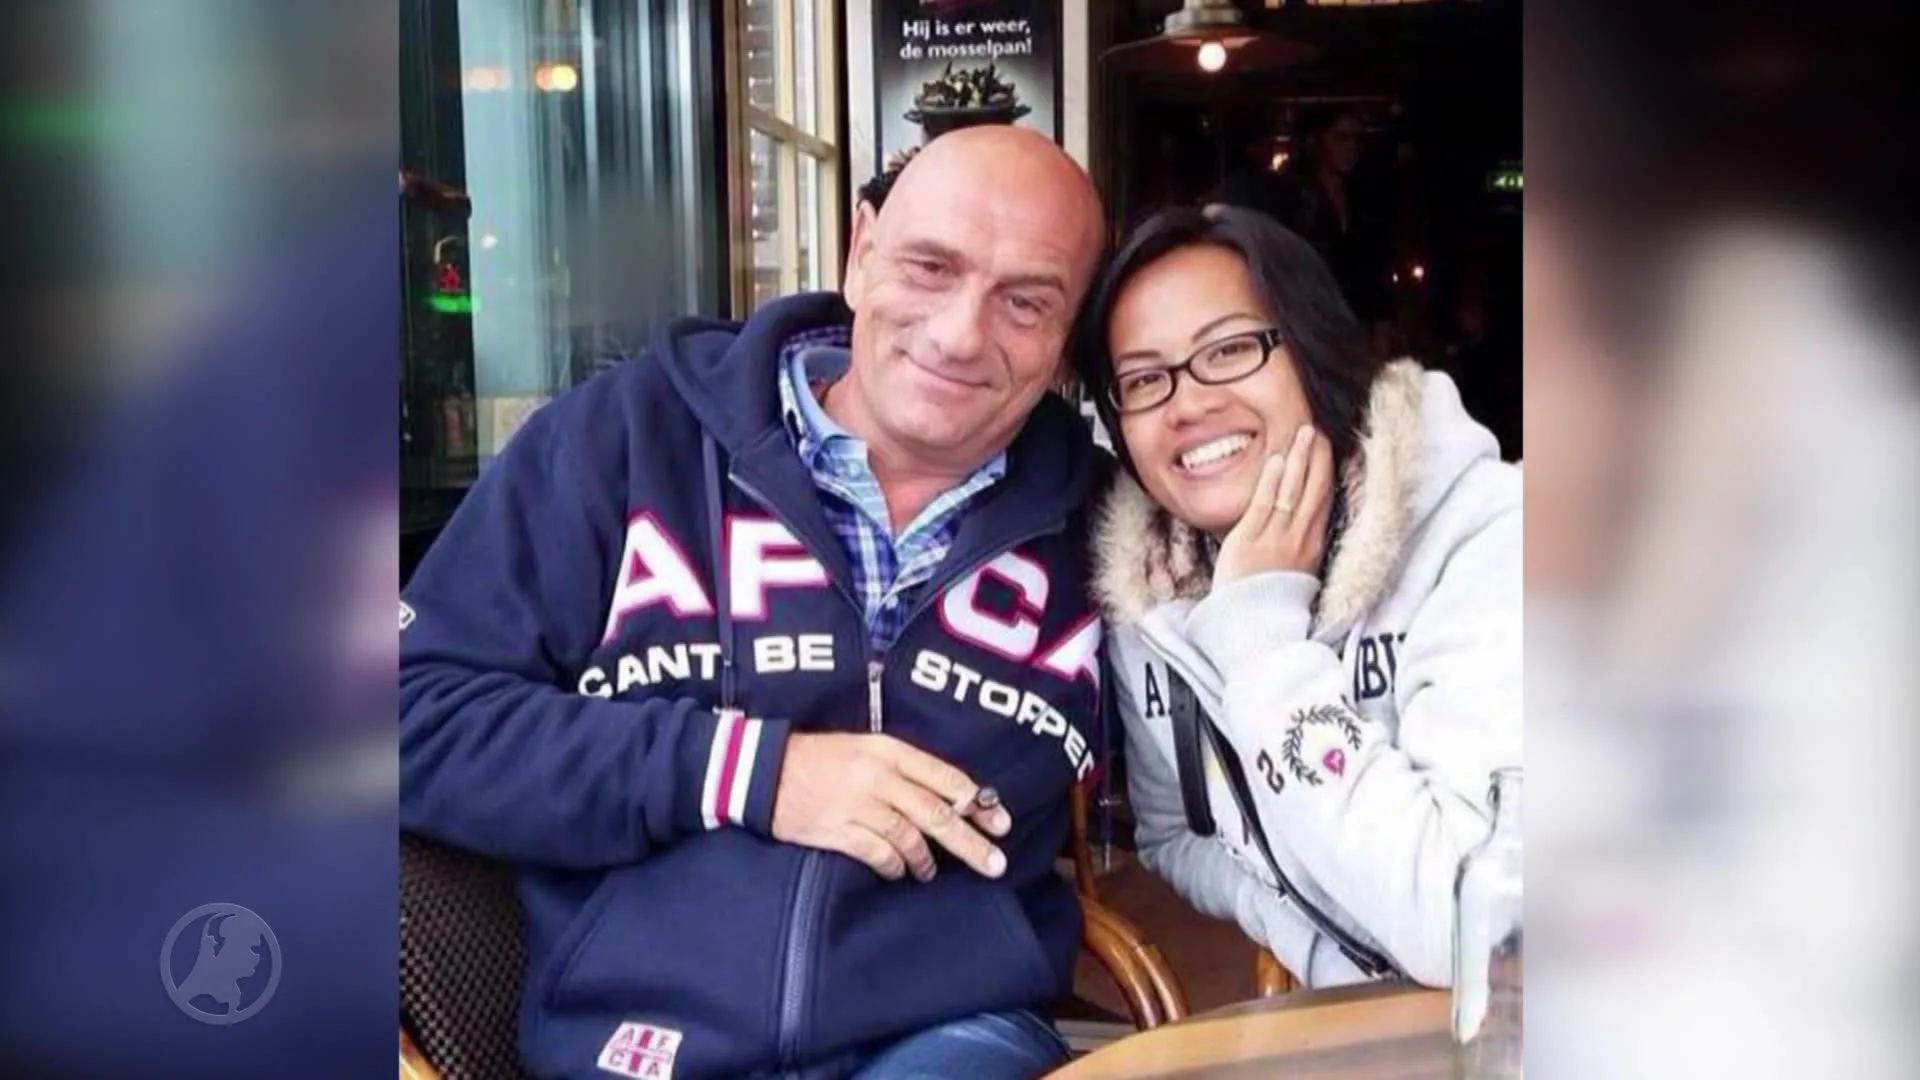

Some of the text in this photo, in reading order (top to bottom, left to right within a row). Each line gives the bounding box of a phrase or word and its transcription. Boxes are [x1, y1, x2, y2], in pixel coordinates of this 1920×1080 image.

[903, 20, 1031, 41] Hij is er weer,
[899, 37, 1032, 60] de mosselpan!
[578, 643, 722, 699] CANT
[753, 634, 835, 674] BE
